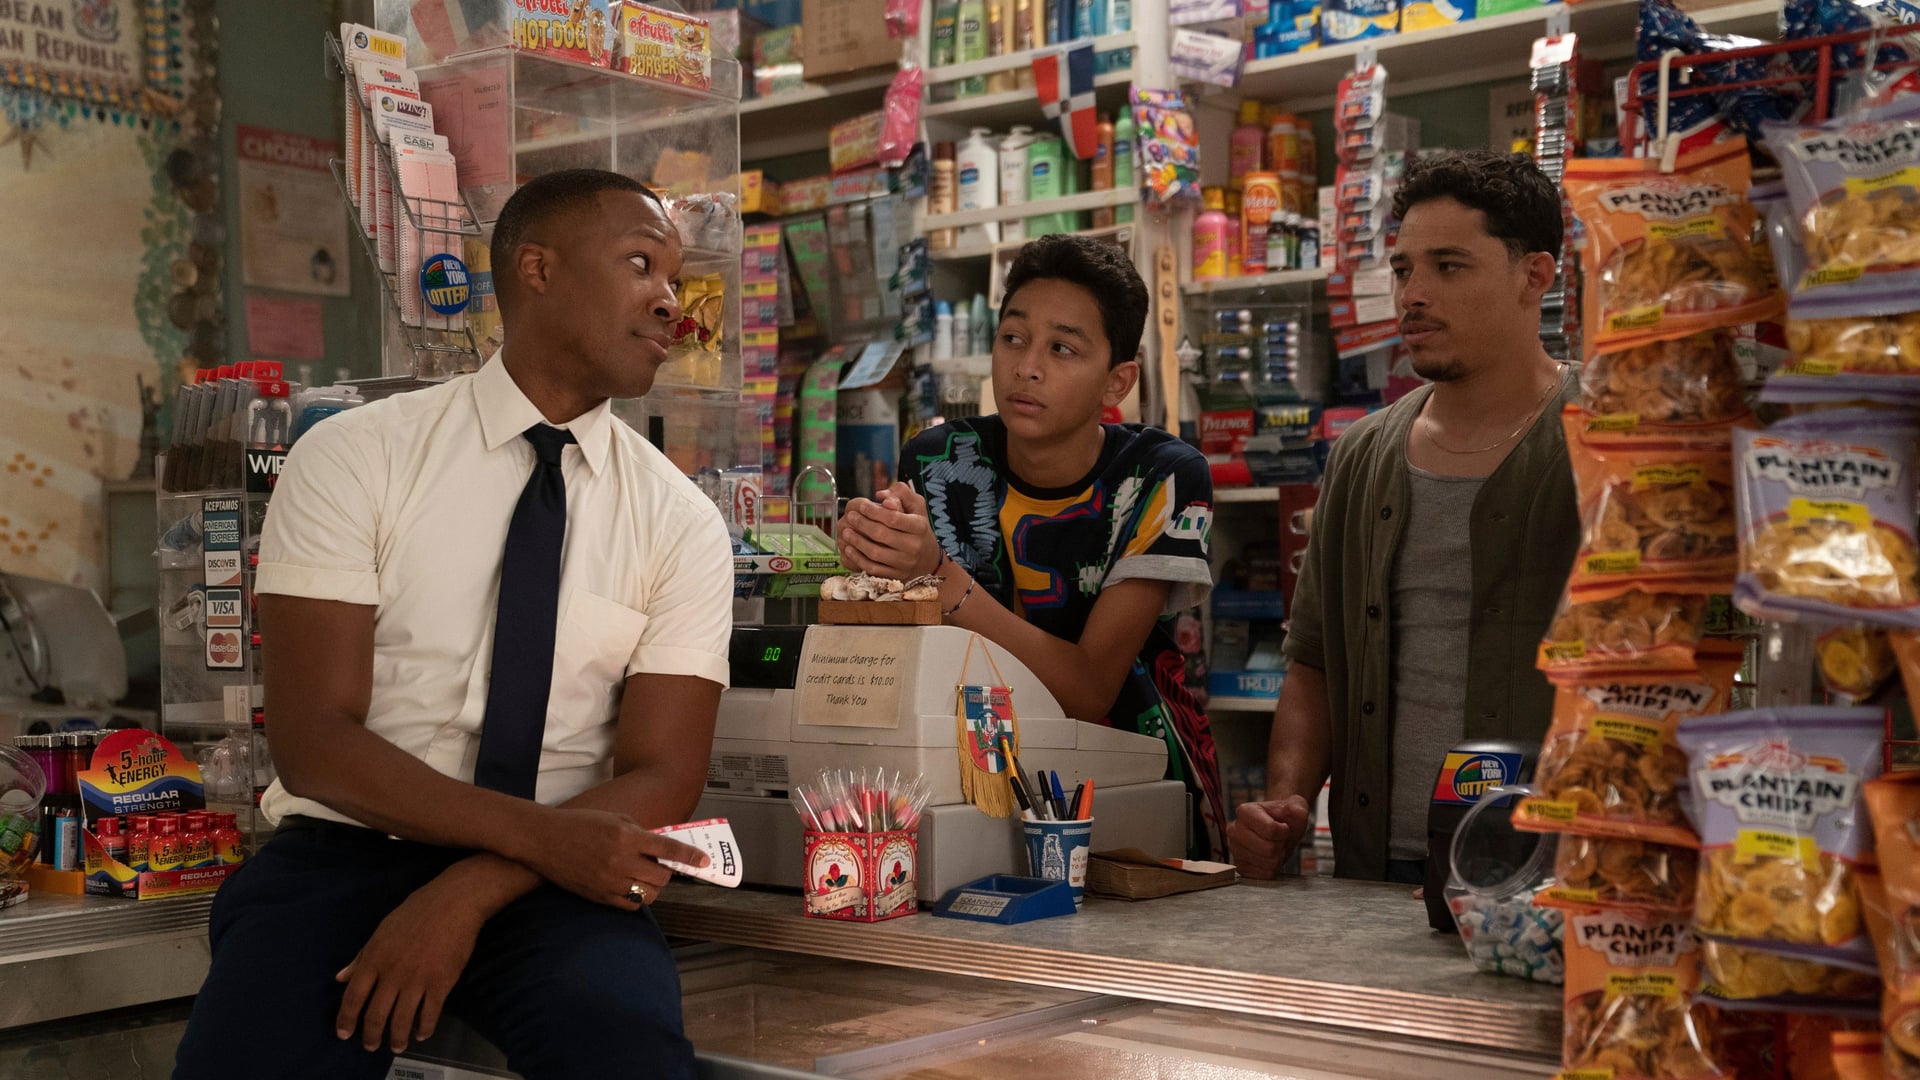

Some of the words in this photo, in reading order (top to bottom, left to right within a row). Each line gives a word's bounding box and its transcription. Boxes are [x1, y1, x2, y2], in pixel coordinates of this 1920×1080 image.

[514, 17, 553, 49] HOT
[553, 20, 588, 49] DOG
[629, 13, 675, 43] efrutti
[36, 31, 129, 74] REPUBLIC
[635, 44, 662, 57] MINI
[629, 55, 678, 78] BURGER
[404, 136, 434, 150] CASH
[443, 259, 462, 271] NEW
[446, 271, 468, 285] YORK
[426, 284, 470, 306] LOTTERY
[1202, 416, 1251, 432] TYLENOL
[205, 499, 239, 512] ACEPTAMOS
[204, 520, 237, 531] AMERICAN
[210, 532, 239, 543] EXPRESS
[208, 558, 236, 569] DISCOVER
[212, 601, 235, 615] VISA
[210, 643, 239, 653] MasterCard
[811, 653, 848, 665] Minimum
[850, 653, 878, 667] charge
[880, 653, 896, 667] for
[806, 673, 831, 684] credit
[833, 674, 855, 685] cards
[857, 676, 865, 686] is
[870, 674, 895, 686] $10.00
[826, 694, 850, 705] Thank
[851, 695, 867, 706] You
[121, 749, 167, 770] 5-hour
[1481, 759, 1499, 769] NEW
[119, 763, 167, 786] ENERGY
[1481, 768, 1503, 780] YORK
[1711, 773, 1845, 799] PLANTAIN
[113, 790, 179, 805] REGULAR
[1740, 793, 1813, 815] CHIPS
[114, 800, 181, 814] STRENGTH
[180, 869, 225, 881] REGULAR
[1610, 940, 1676, 957] CHIPS
